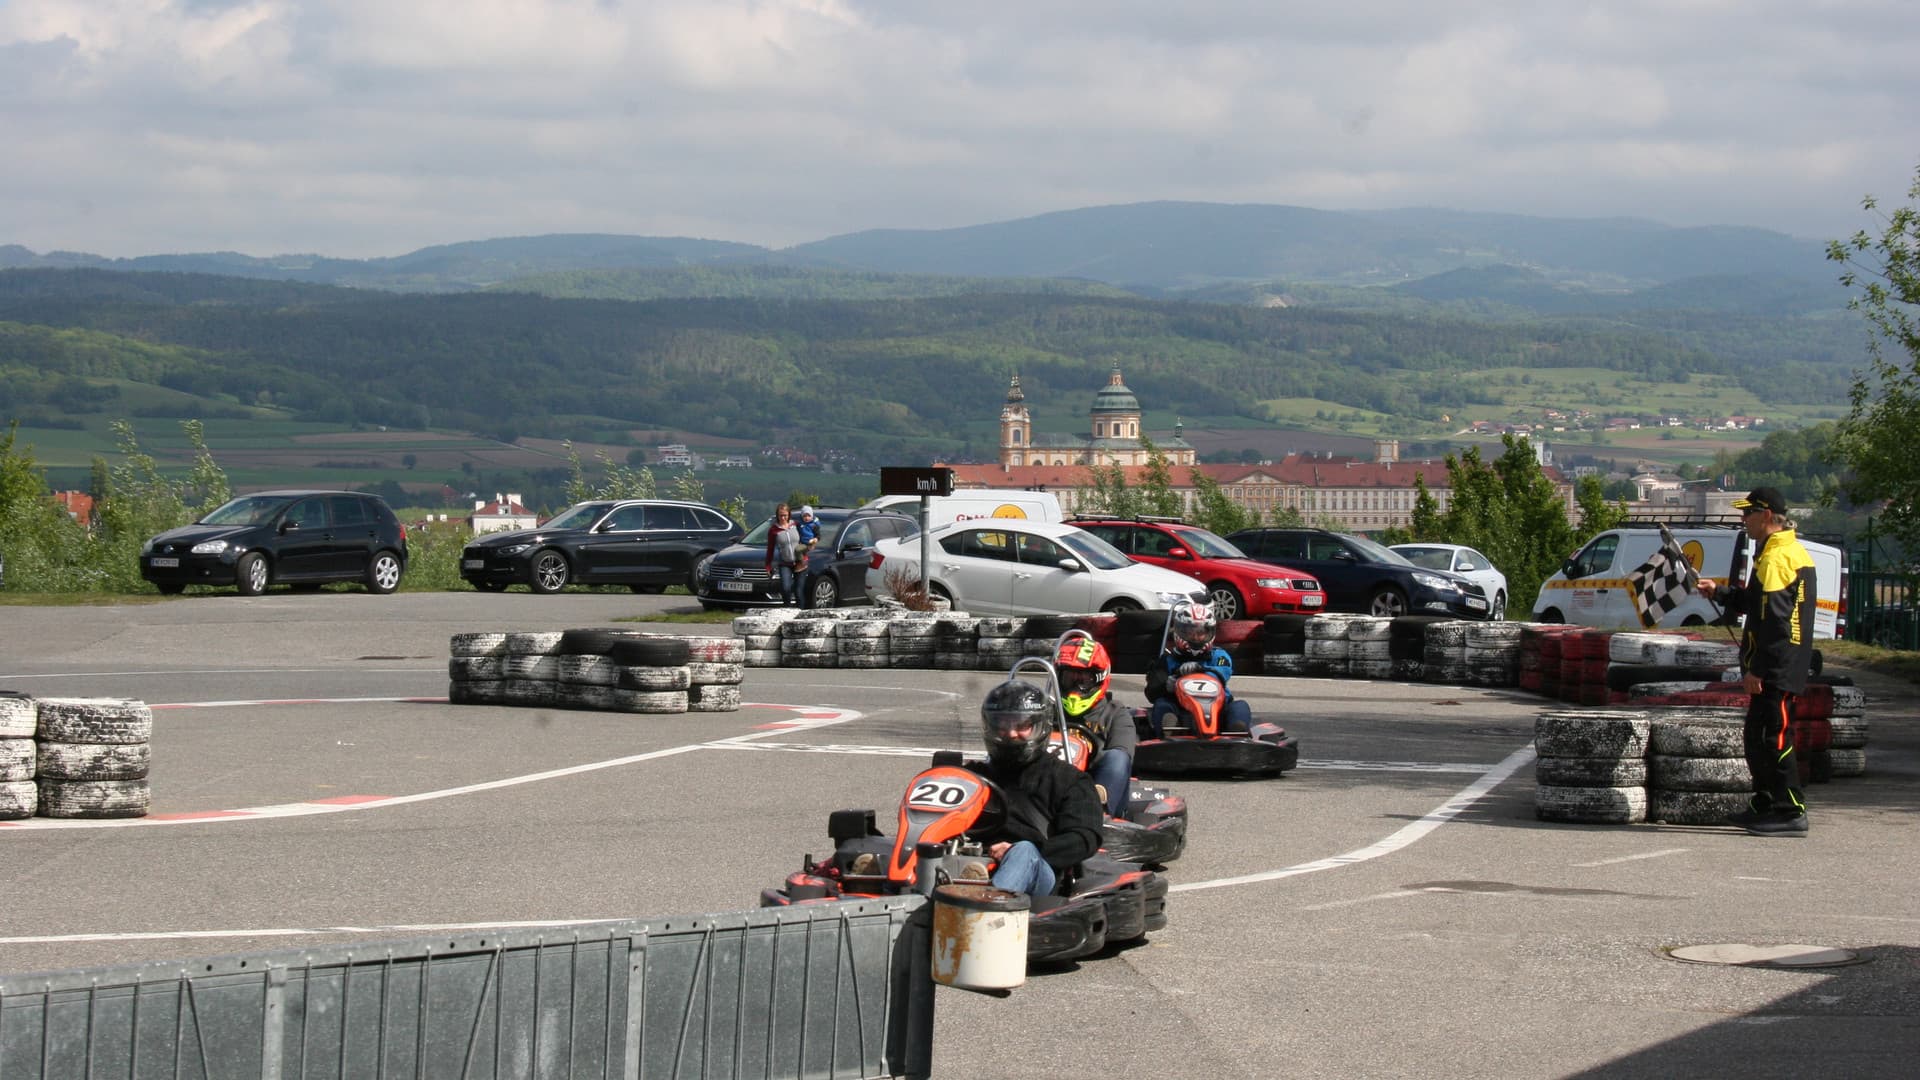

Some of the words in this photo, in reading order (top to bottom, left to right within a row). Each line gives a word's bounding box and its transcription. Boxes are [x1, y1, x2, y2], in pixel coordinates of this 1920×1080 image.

[916, 477, 937, 491] km/h
[1192, 681, 1207, 691] 7
[909, 783, 965, 805] 20
